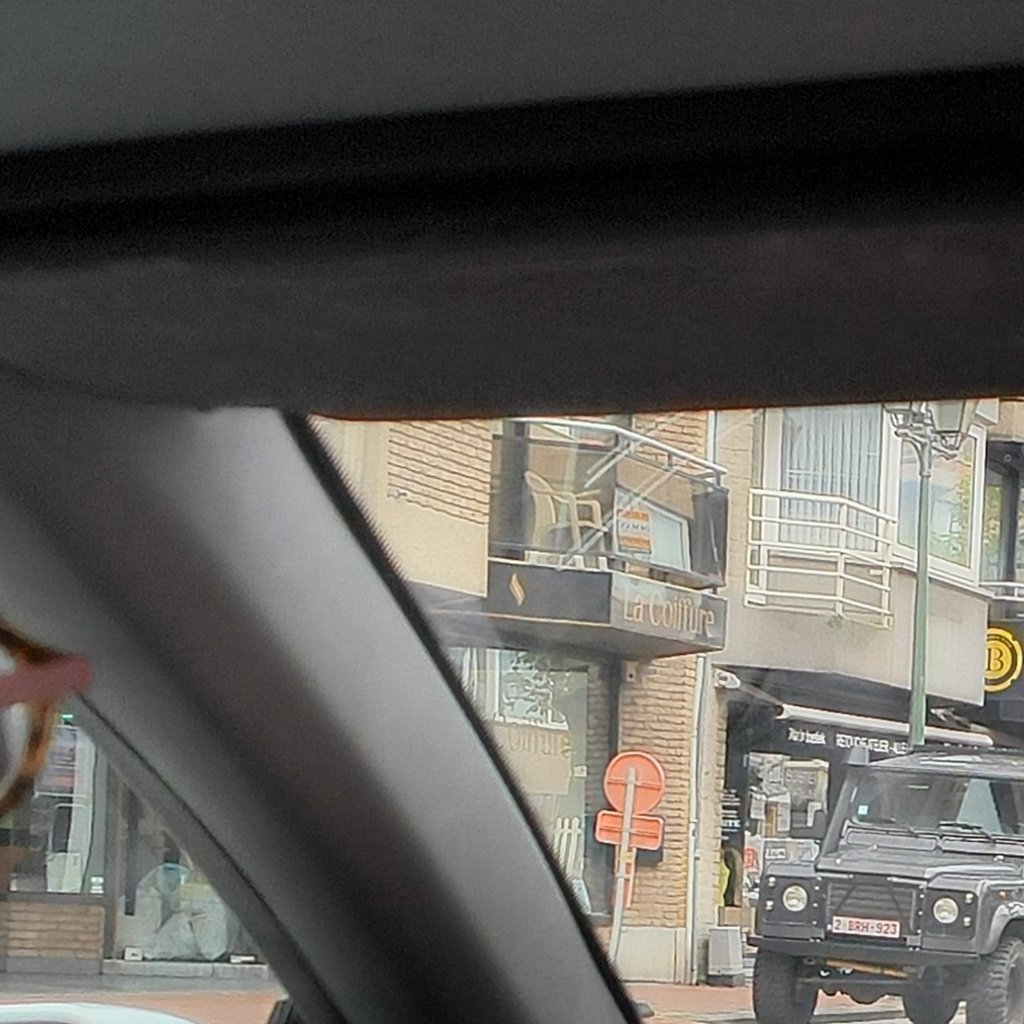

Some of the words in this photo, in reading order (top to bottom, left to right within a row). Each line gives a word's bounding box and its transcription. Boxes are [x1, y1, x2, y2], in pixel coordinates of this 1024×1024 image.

[623, 590, 643, 622] La
[648, 593, 716, 638] Coiffure
[985, 648, 1004, 672] B
